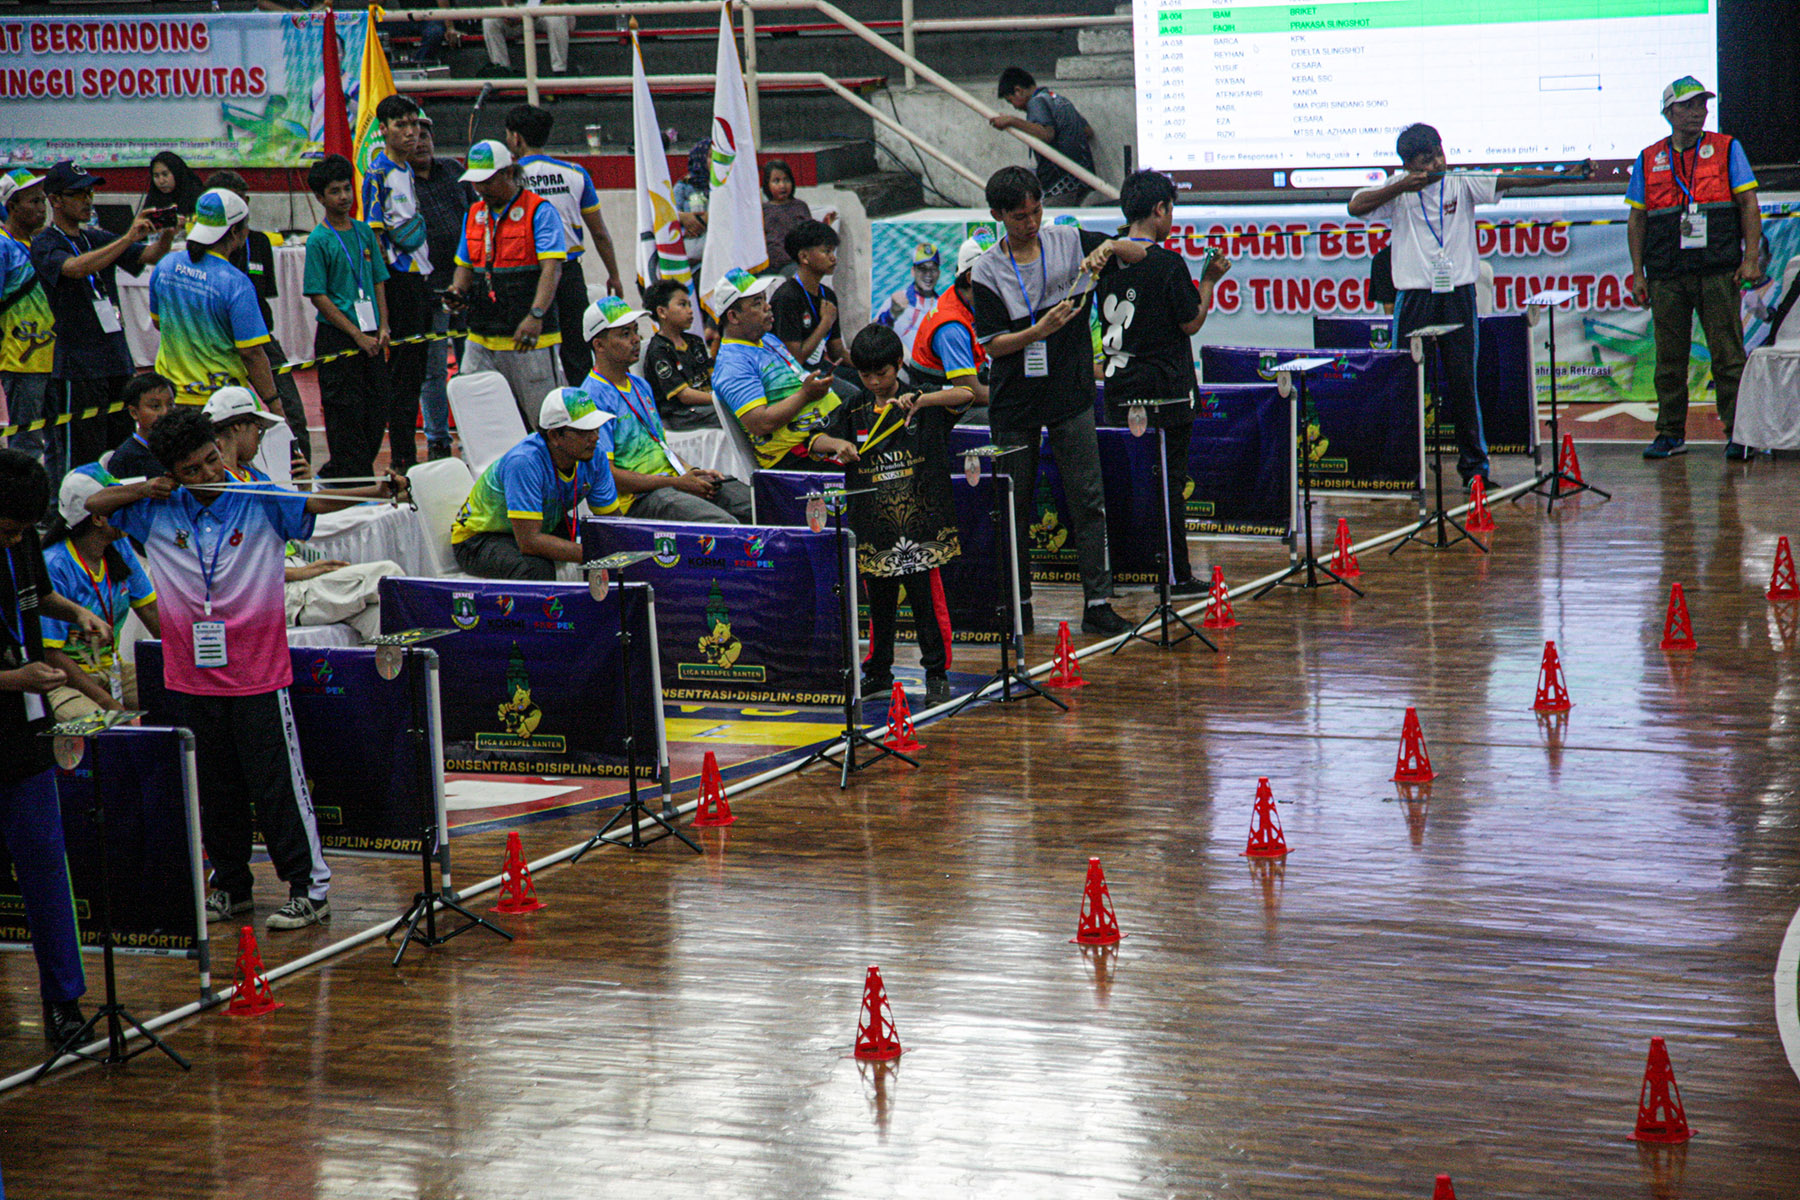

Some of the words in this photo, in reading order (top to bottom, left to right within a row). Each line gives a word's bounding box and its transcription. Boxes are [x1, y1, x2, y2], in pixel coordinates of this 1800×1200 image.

[1290, 7, 1316, 16] BRIKET
[1290, 21, 1325, 30] PRAKASA
[1327, 18, 1370, 28] SLINGSHOT
[31, 23, 208, 51] BERTANDING
[1213, 51, 1245, 59] REYHAN
[1322, 46, 1366, 55] SLINGSHOT
[1214, 64, 1239, 72] YUSUF
[1291, 61, 1322, 69] CESARA
[82, 67, 266, 96] SPORTIVITAS
[1292, 75, 1315, 83] KEBAL
[1292, 88, 1318, 96] KANDA
[1331, 100, 1364, 109] SINDANG
[1293, 115, 1324, 124] CESARA
[1359, 126, 1384, 135] UMMU
[1485, 146, 1517, 155] dewasa
[1519, 144, 1539, 157] putri
[1217, 153, 1235, 161] Form
[1238, 152, 1278, 162] Responses
[175, 264, 207, 281] PANITIA
[1570, 365, 1612, 377] Rekreasi
[733, 670, 762, 678] BANTEN
[480, 739, 497, 747] LIGA
[499, 740, 531, 748] KATAPEL
[532, 741, 562, 749] BANTEN
